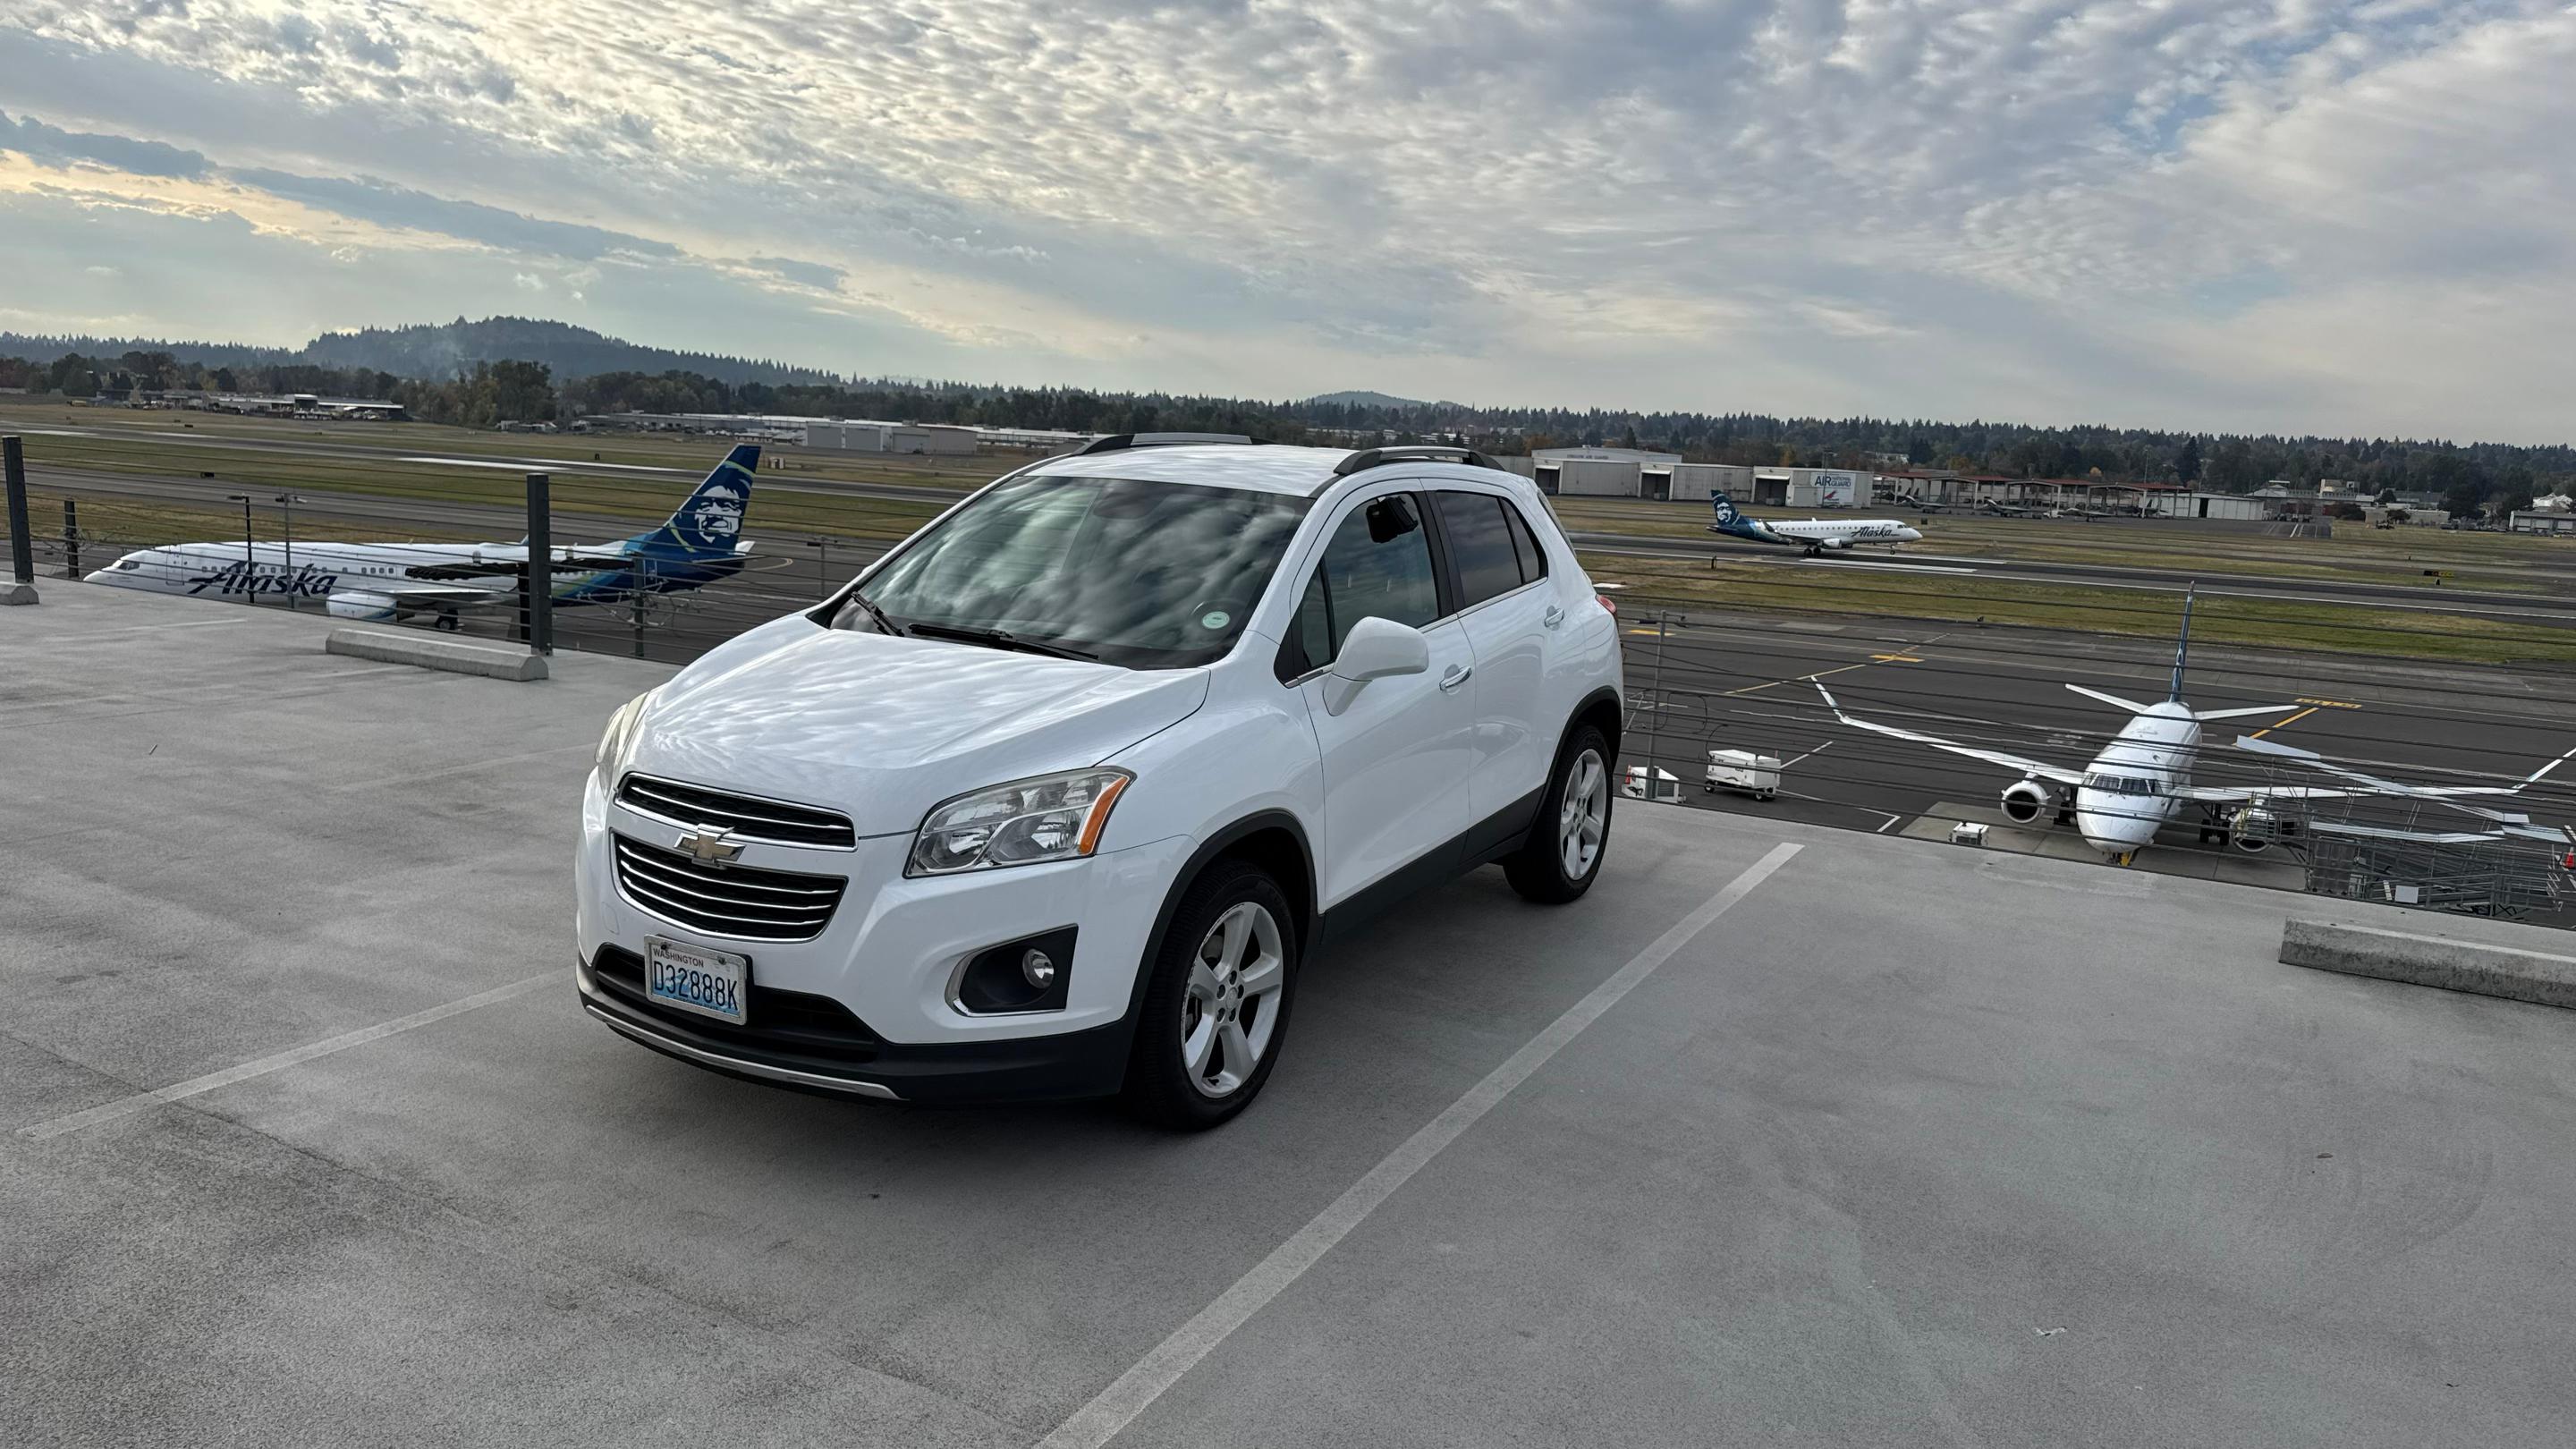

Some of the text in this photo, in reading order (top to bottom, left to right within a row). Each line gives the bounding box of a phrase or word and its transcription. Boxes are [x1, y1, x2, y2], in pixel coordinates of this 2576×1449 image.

[1814, 475, 1832, 487] AIR
[1851, 526, 1893, 538] Alaska
[653, 946, 704, 968] WASHINGTON
[654, 961, 738, 1011] D32888K
